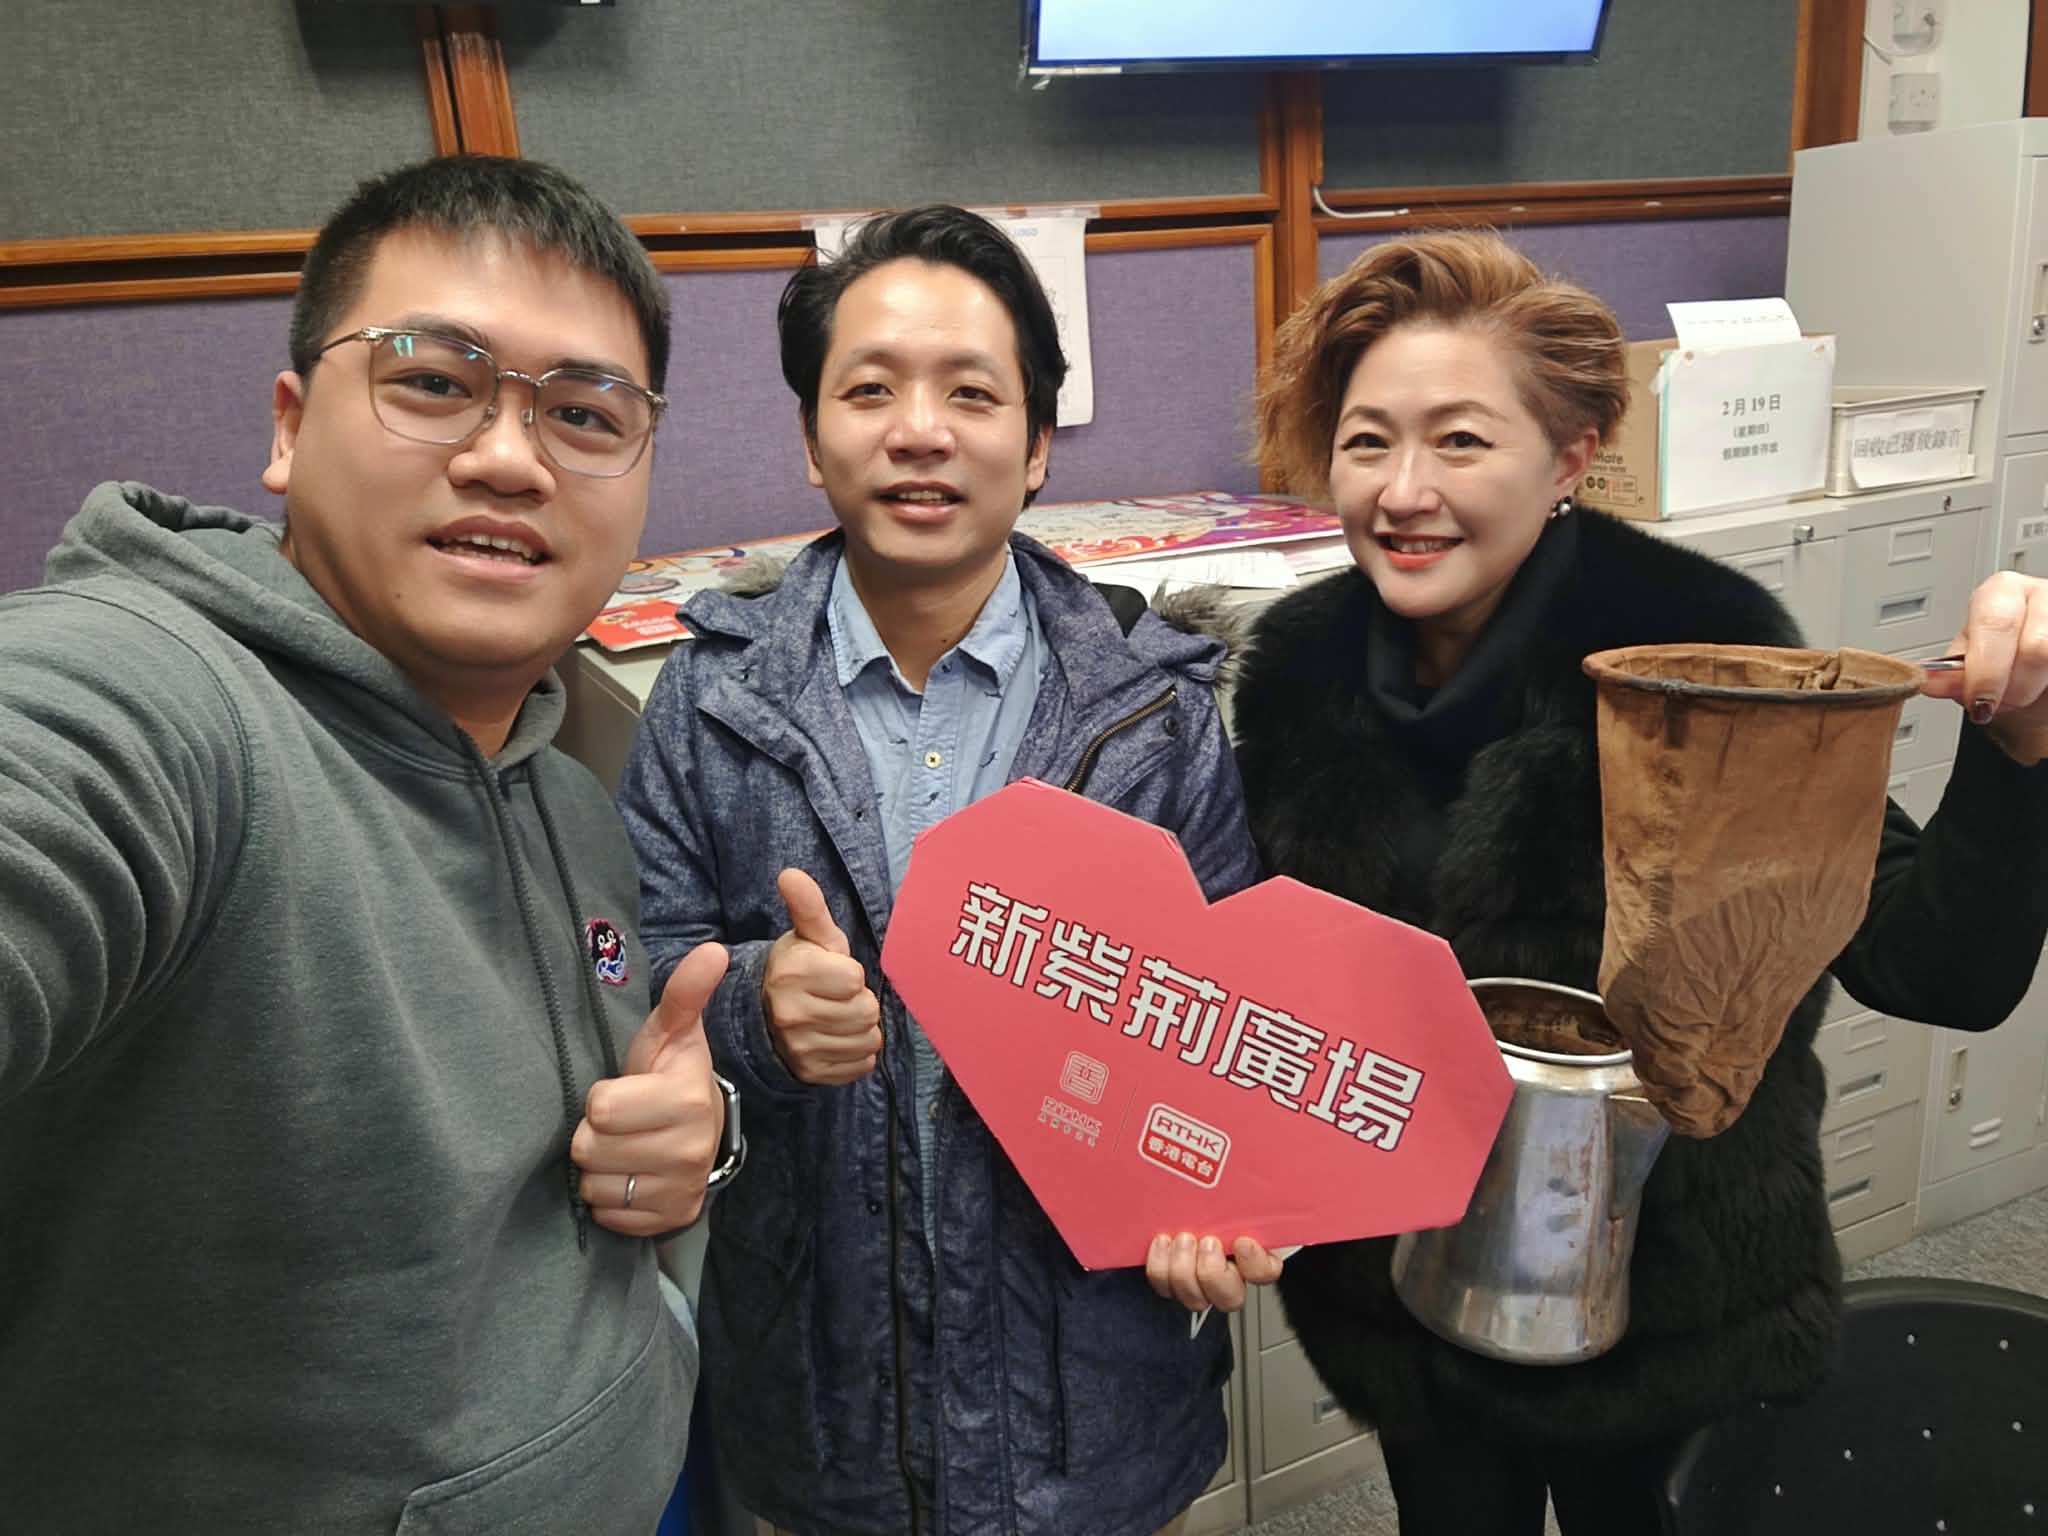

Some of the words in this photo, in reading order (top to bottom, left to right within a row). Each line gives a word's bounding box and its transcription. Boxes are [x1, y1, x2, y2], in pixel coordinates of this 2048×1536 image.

[950, 880, 1424, 1152] 新紫荊廣場
[1147, 1135, 1214, 1177] 香港電台
[1156, 1115, 1220, 1155] RTHK
